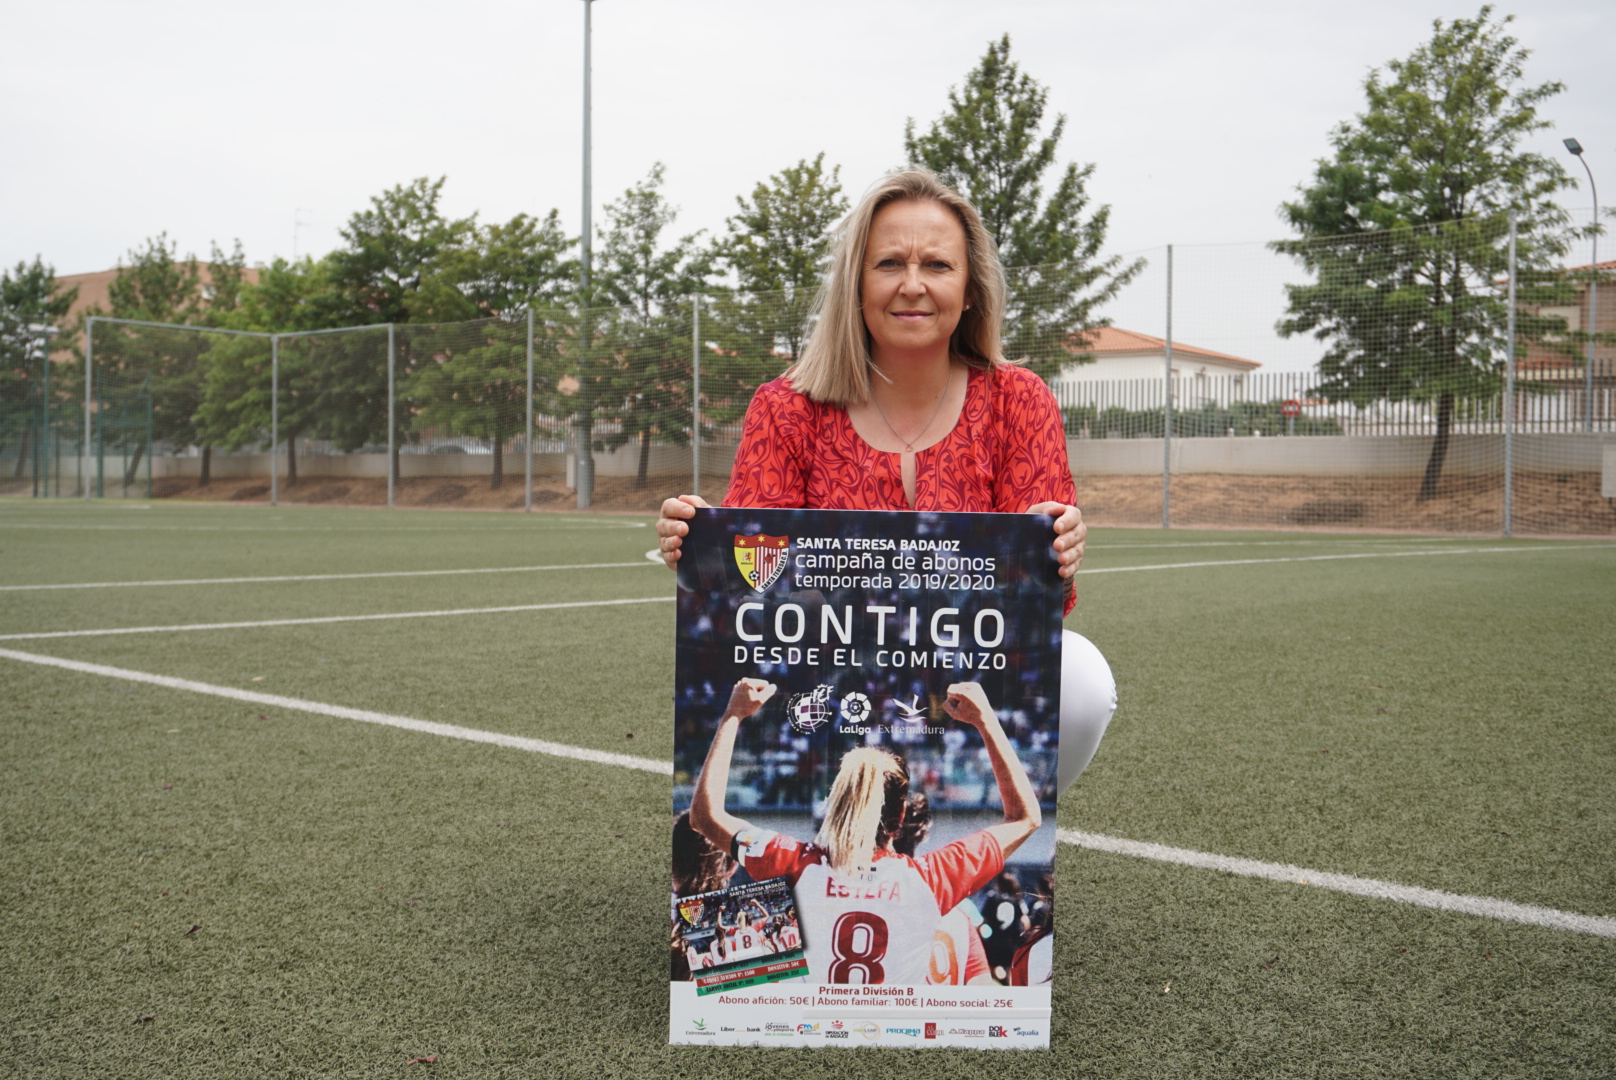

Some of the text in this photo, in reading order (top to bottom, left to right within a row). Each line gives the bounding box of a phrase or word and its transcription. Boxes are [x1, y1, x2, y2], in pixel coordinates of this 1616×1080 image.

[796, 537, 960, 552] SANTA TERESA BADAJOZ
[795, 552, 996, 573] campaña de abonos
[795, 573, 995, 592] temporada 2019/2020
[735, 602, 1005, 648] CONTIGO
[734, 645, 1007, 671] DESDE EL COMIENZO
[839, 725, 871, 736] LaLiga
[877, 724, 945, 736] Extremadura
[729, 889, 745, 898] SANTA
[746, 885, 764, 894] TERESA
[742, 935, 753, 949] 8
[819, 986, 914, 997] Primera División B
[718, 995, 750, 1005] Abono
[752, 995, 787, 1005] afición:
[789, 997, 810, 1006] 50€
[817, 997, 849, 1006] Abono
[851, 997, 892, 1007] familiar:
[895, 998, 918, 1007] 100€
[926, 999, 957, 1007] Abono
[960, 999, 991, 1008] social:
[993, 999, 1014, 1008] 25€
[1016, 1029, 1039, 1037] aqualia
